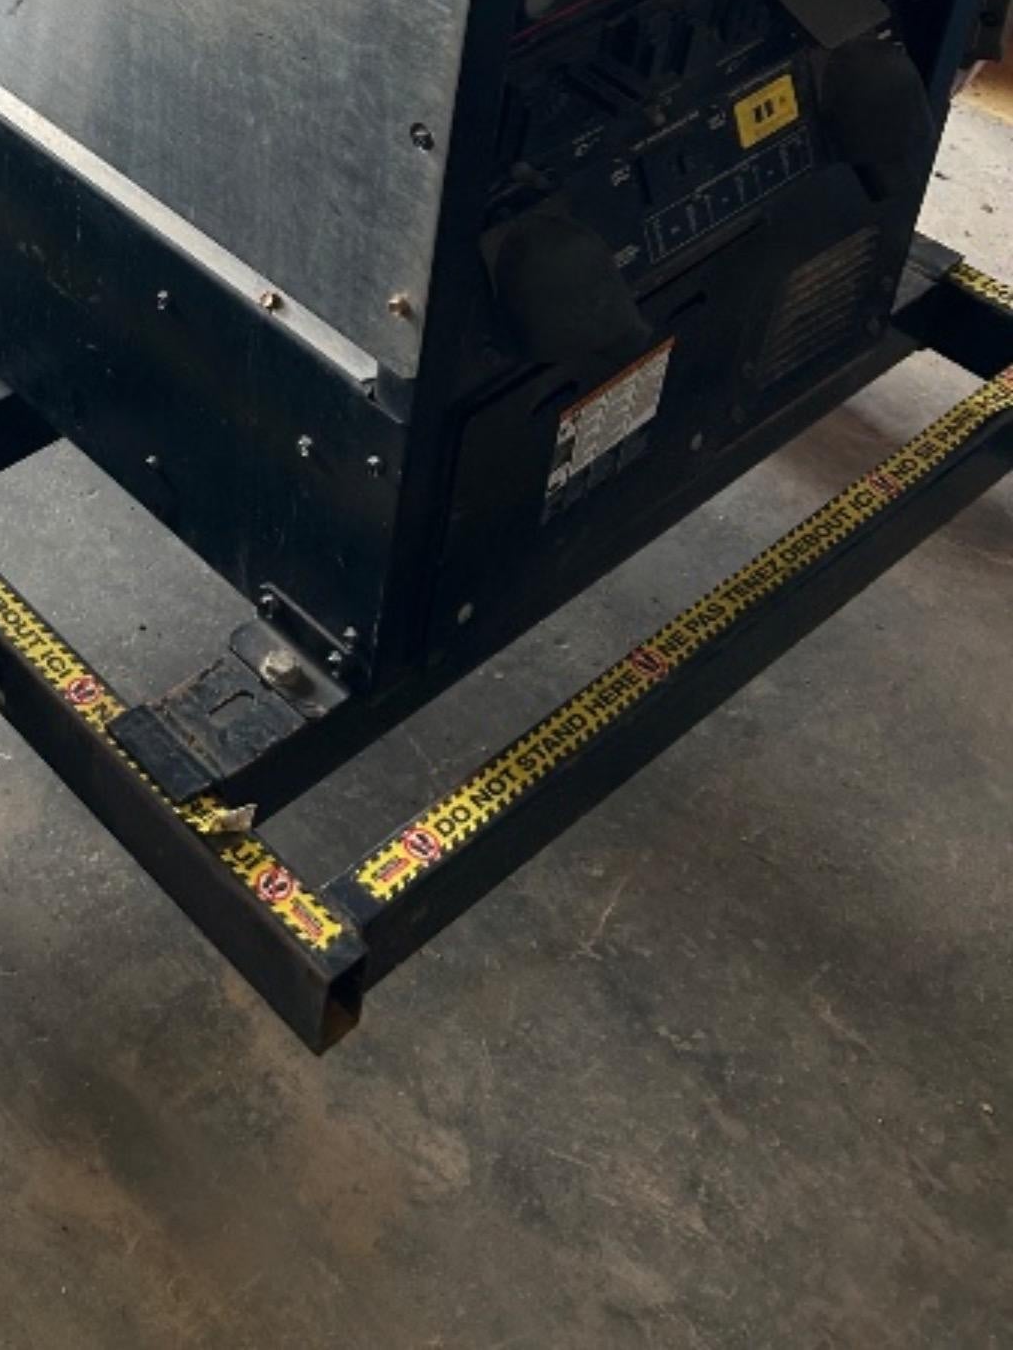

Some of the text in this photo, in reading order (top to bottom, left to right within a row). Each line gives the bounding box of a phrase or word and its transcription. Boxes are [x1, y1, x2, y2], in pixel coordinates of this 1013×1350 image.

[656, 630, 688, 657] NE
[688, 601, 726, 634] PAS
[782, 506, 853, 565] DEBOUT
[39, 643, 74, 681] ICI
[433, 667, 642, 835] DO NOT STAND HERE
